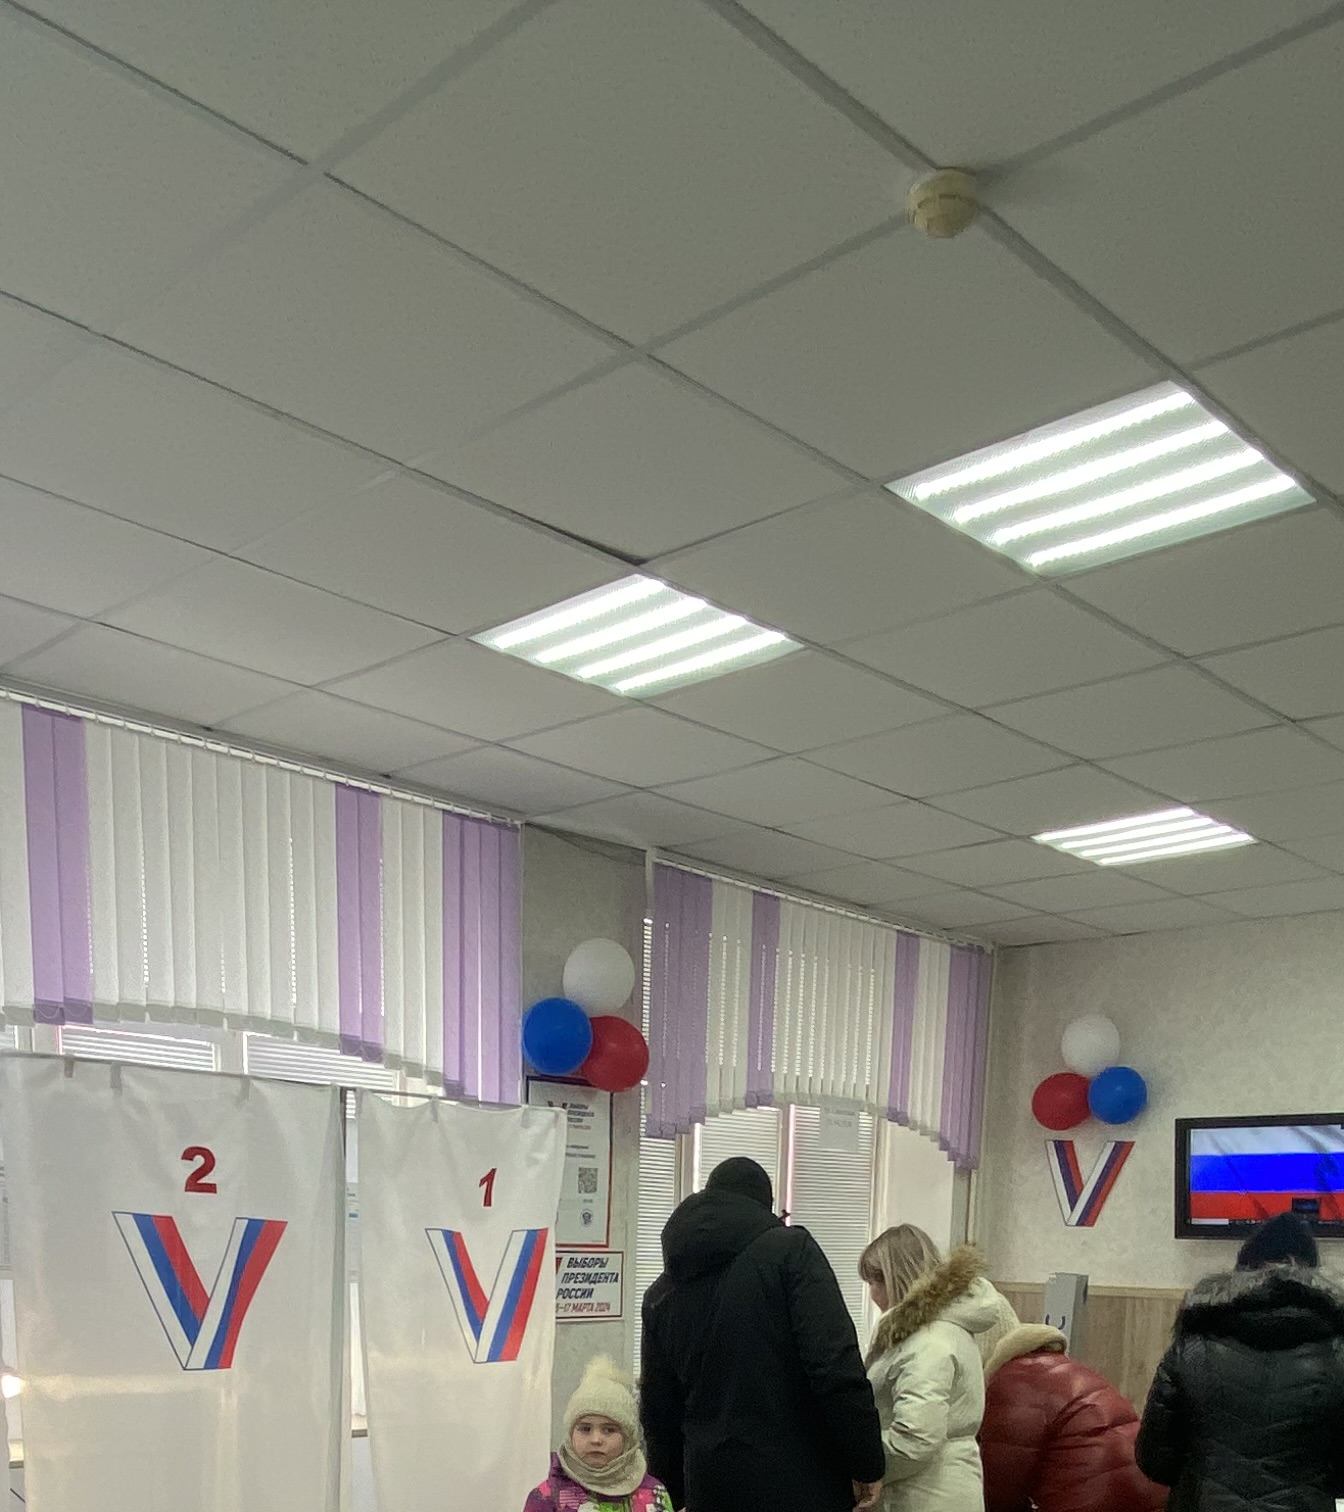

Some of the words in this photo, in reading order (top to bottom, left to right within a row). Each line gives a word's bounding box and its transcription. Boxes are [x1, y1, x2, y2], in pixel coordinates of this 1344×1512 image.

[181, 1146, 218, 1194] 2
[479, 1168, 497, 1207] 1
[566, 1256, 610, 1269] ВЫБОРЫ
[561, 1271, 620, 1285] ПРЕЗИДЕНТА
[555, 1287, 594, 1300] РОССИИ
